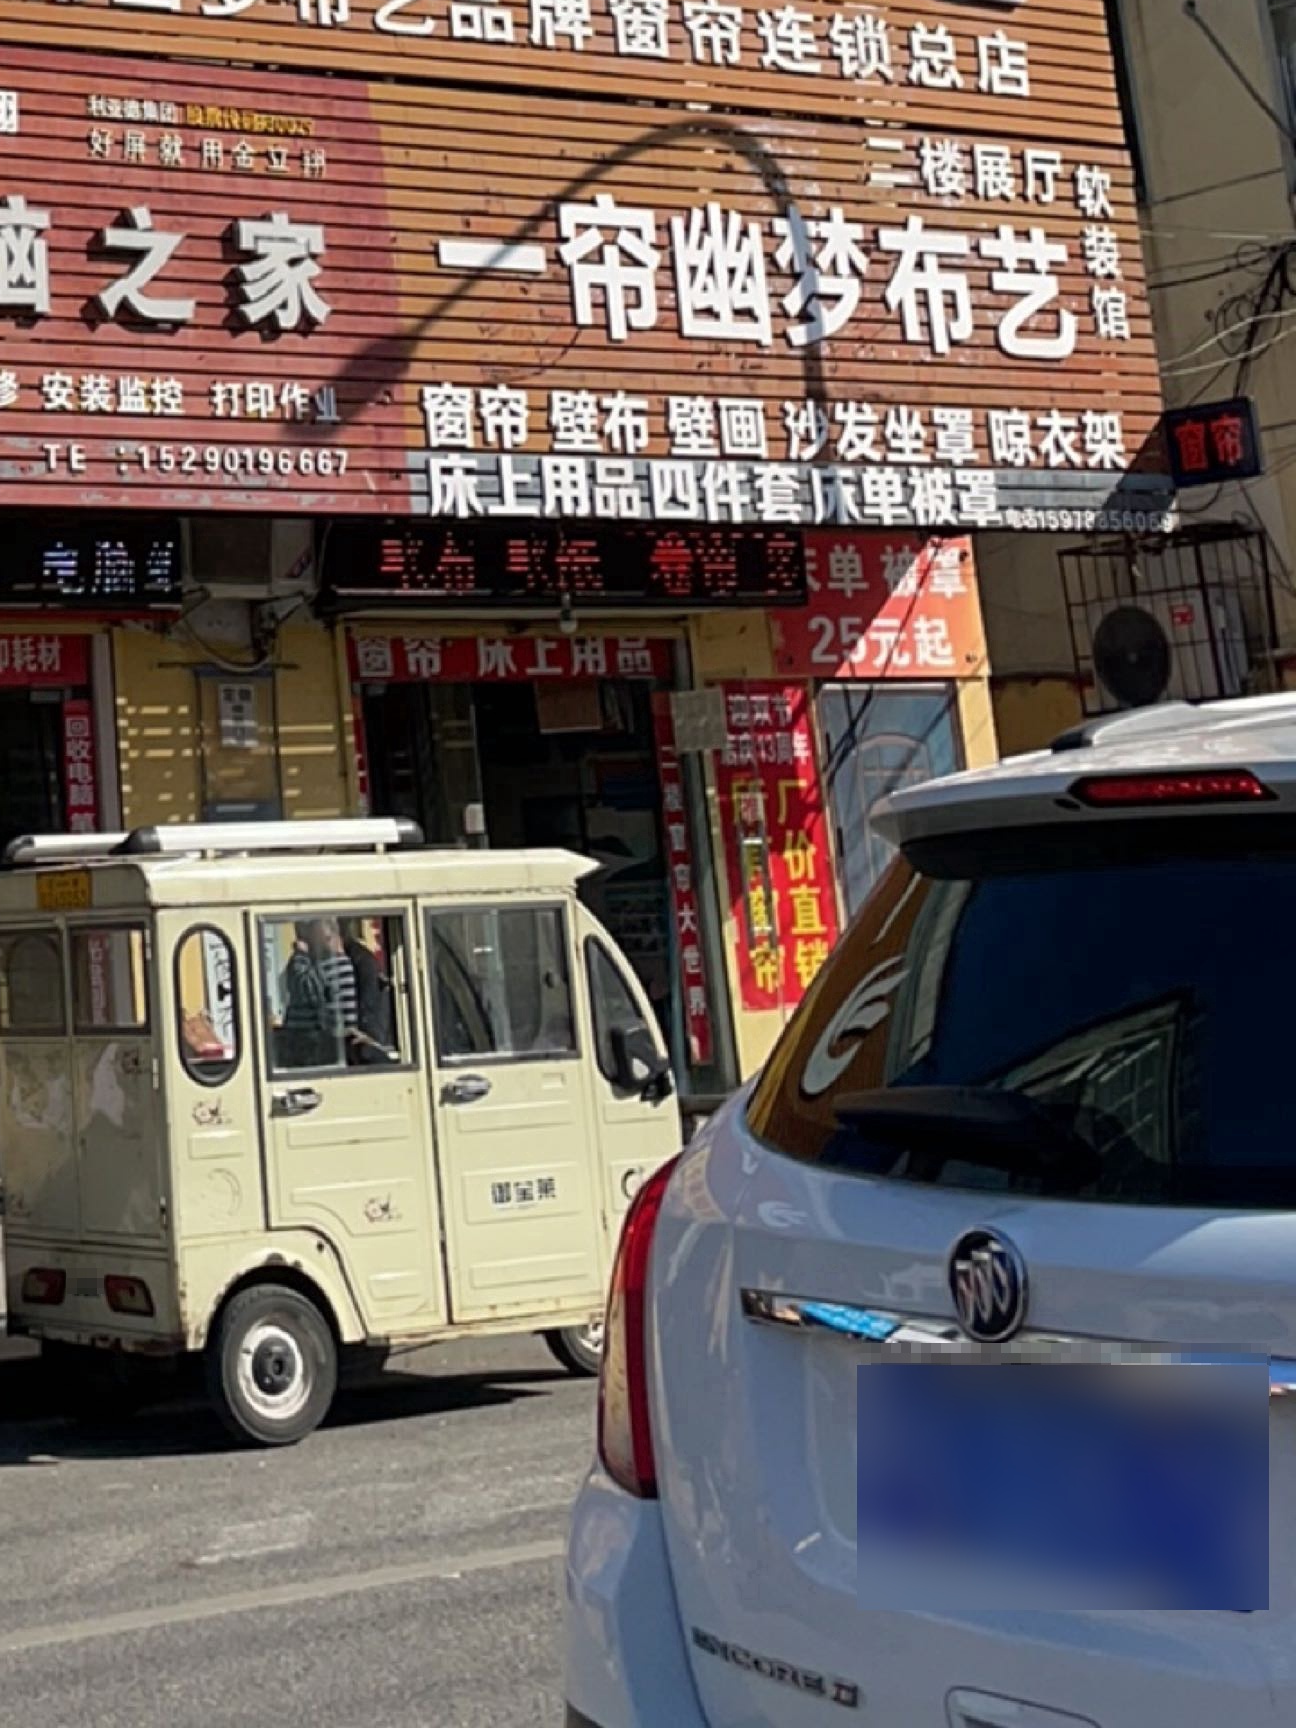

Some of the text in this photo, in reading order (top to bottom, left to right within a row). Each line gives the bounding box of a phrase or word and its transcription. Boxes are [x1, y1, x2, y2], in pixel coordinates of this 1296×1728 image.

[439, 194, 1078, 360] 一帘幽梦布艺
[1075, 164, 1131, 340] 软装馆
[41, 370, 185, 416] 安装监控
[211, 380, 341, 424] 打印作业
[422, 382, 529, 449] 窗帘
[551, 389, 650, 454] 壁布
[668, 395, 769, 459] 壁画
[807, 615, 957, 668] 25元起
